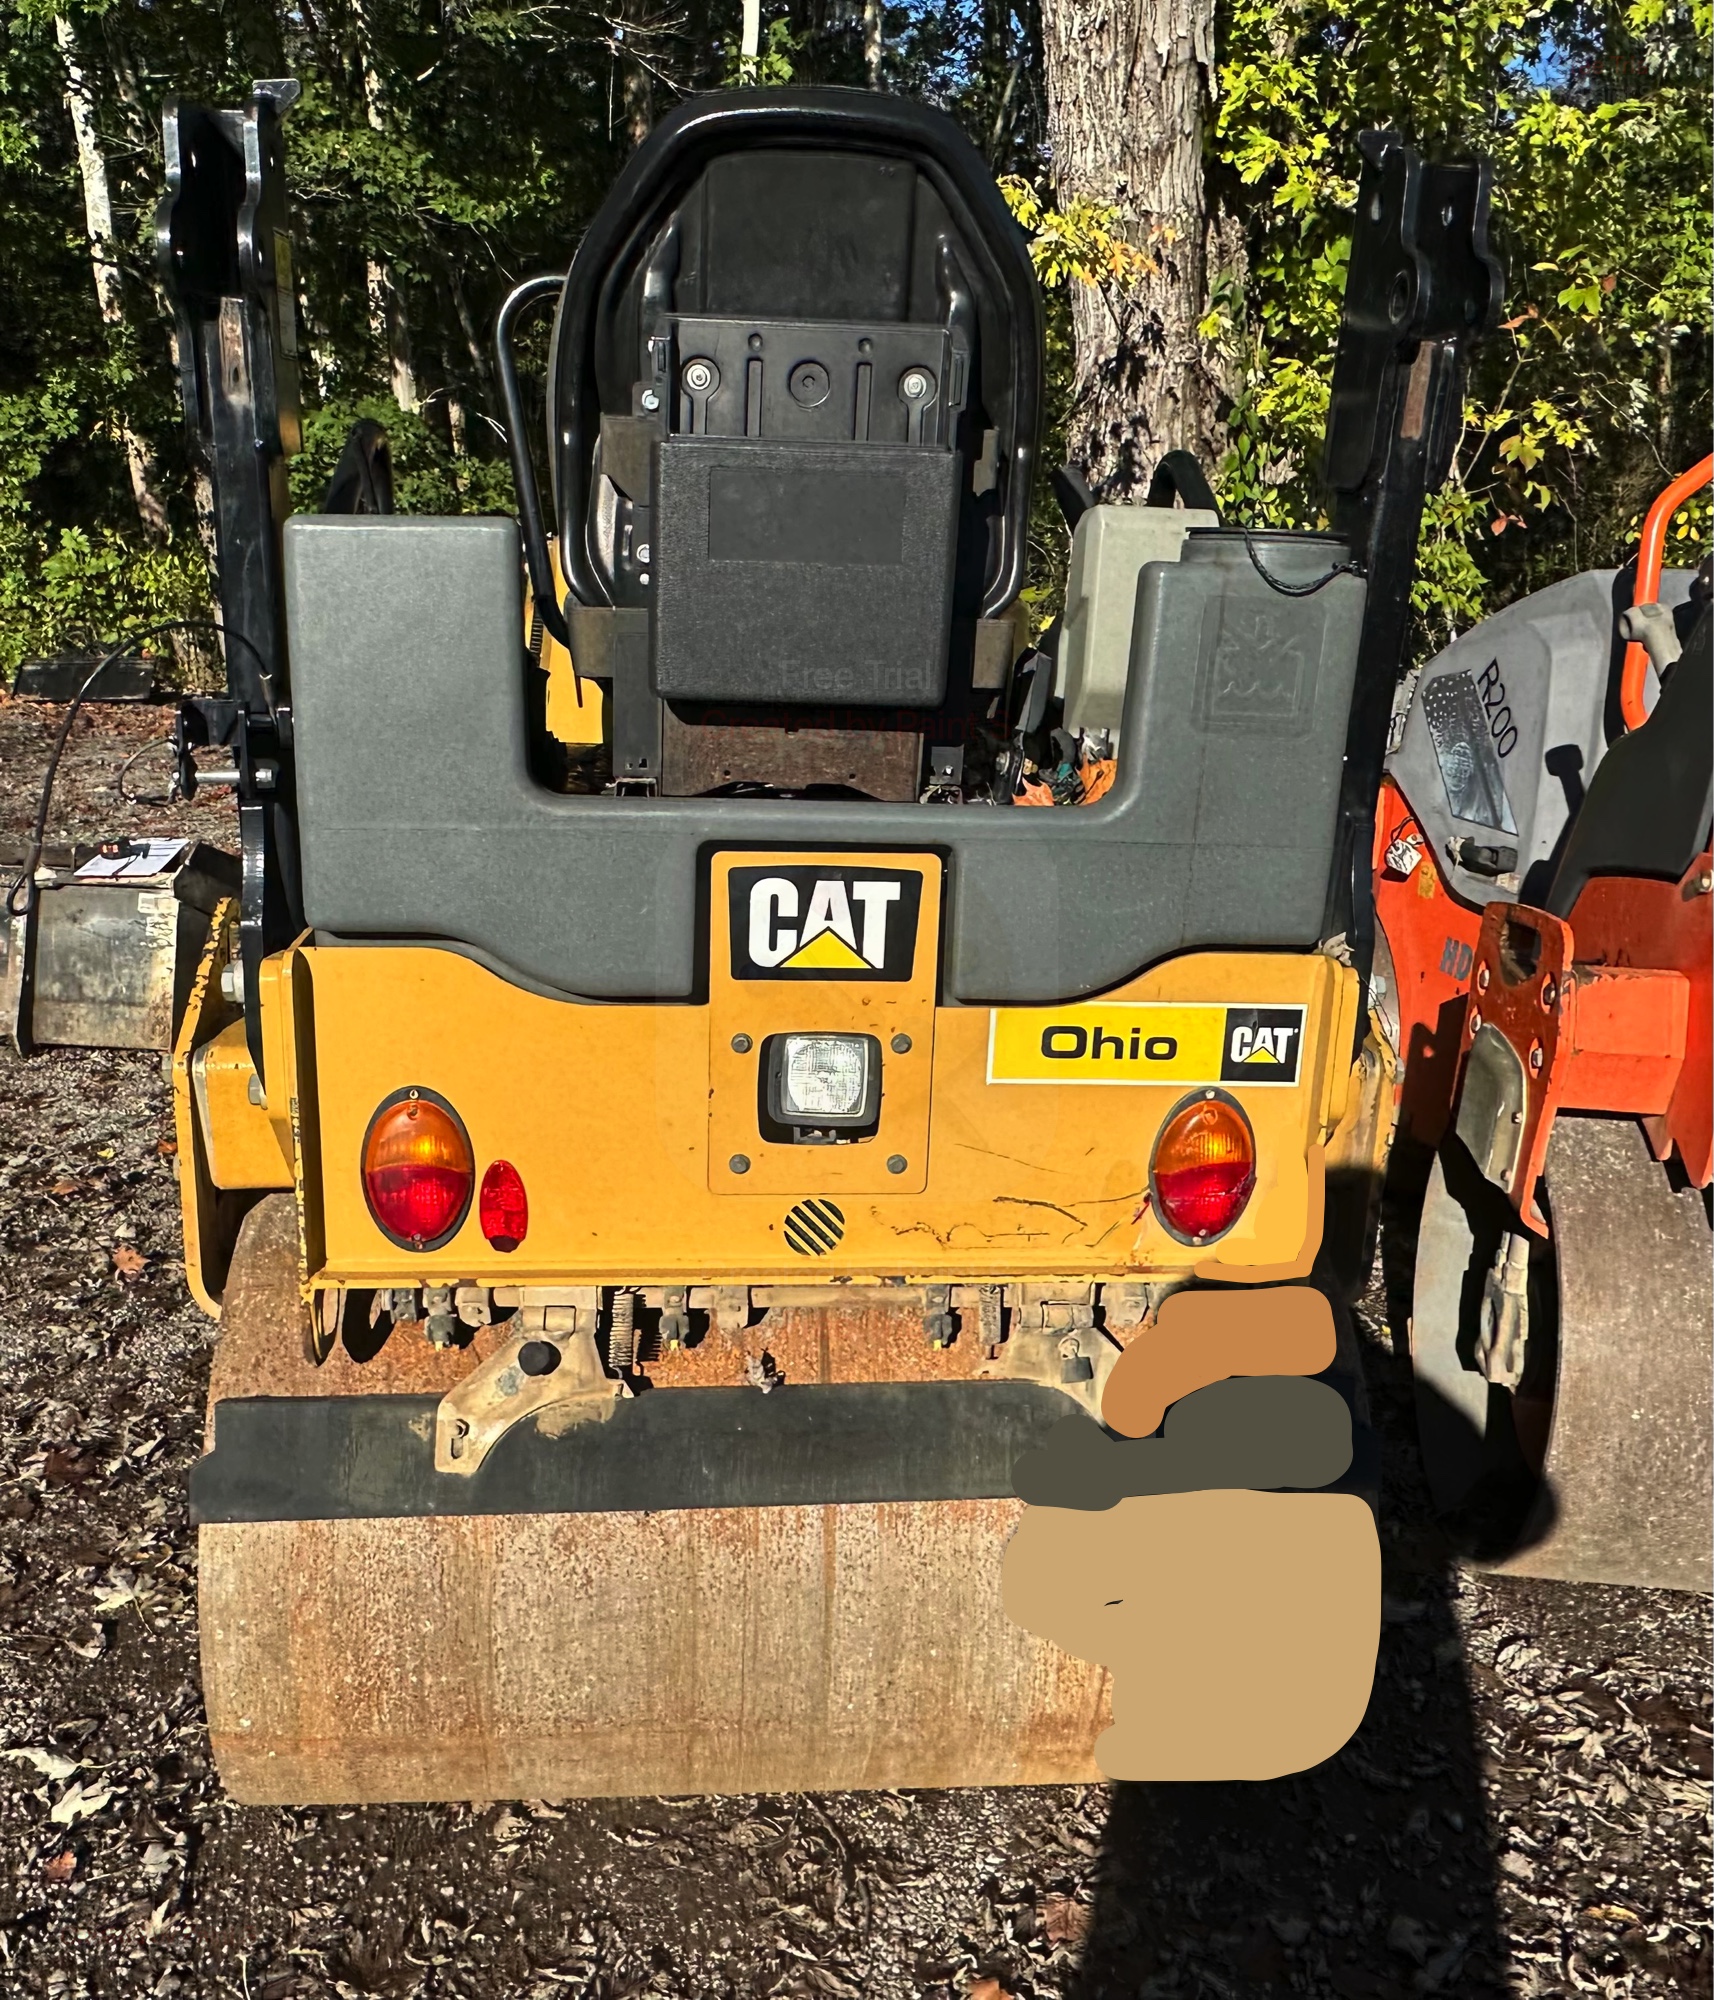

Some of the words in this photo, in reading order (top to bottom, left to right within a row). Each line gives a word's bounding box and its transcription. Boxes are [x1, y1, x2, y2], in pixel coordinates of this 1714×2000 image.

[1477, 656, 1519, 759] R200
[748, 877, 902, 969] CAT
[1440, 936, 1474, 982] HD
[1040, 1025, 1179, 1061] Ohio
[1230, 1026, 1295, 1064] CAT
